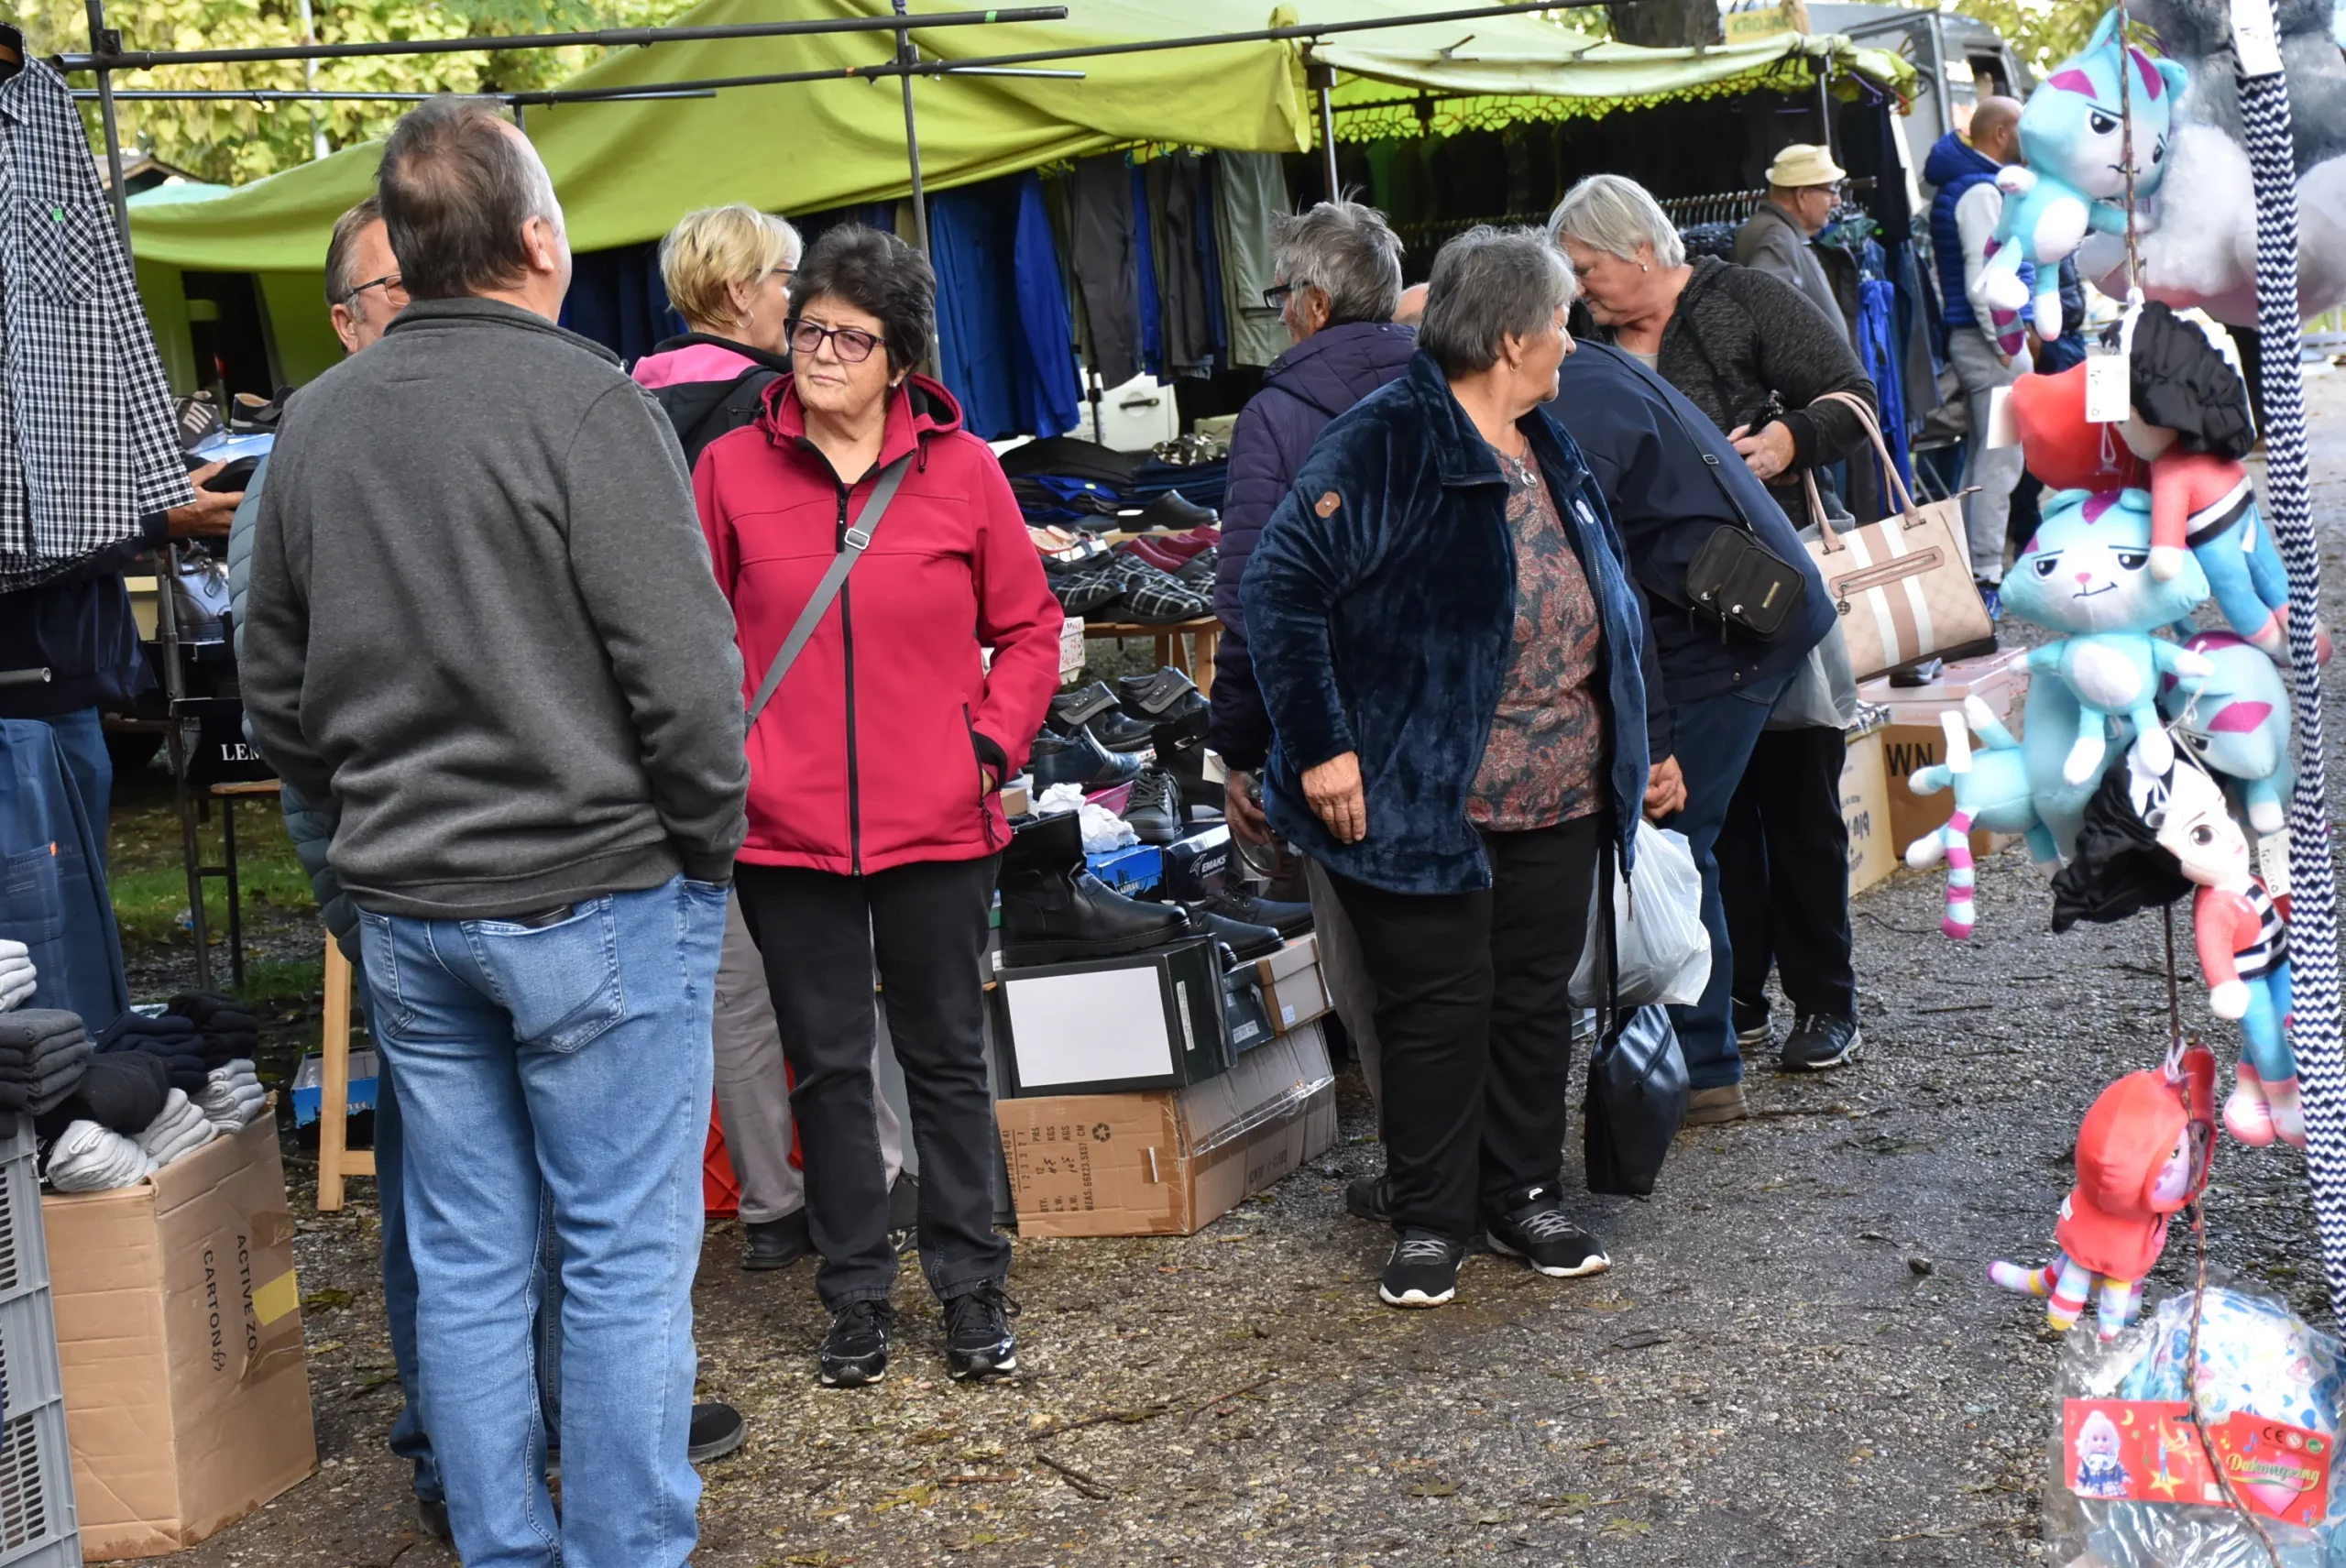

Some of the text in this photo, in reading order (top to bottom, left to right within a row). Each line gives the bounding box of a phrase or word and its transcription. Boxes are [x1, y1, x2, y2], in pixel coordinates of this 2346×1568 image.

[1002, 1130, 1010, 1138] 41
[1031, 1126, 1041, 1142] PRS
[1046, 1125, 1056, 1142] KGS
[1061, 1124, 1070, 1141] KGS
[1076, 1124, 1086, 1137] CM
[1003, 1139, 1012, 1149] 40
[1036, 1167, 1045, 1175] 12
[236, 1234, 255, 1317] ACTIVE
